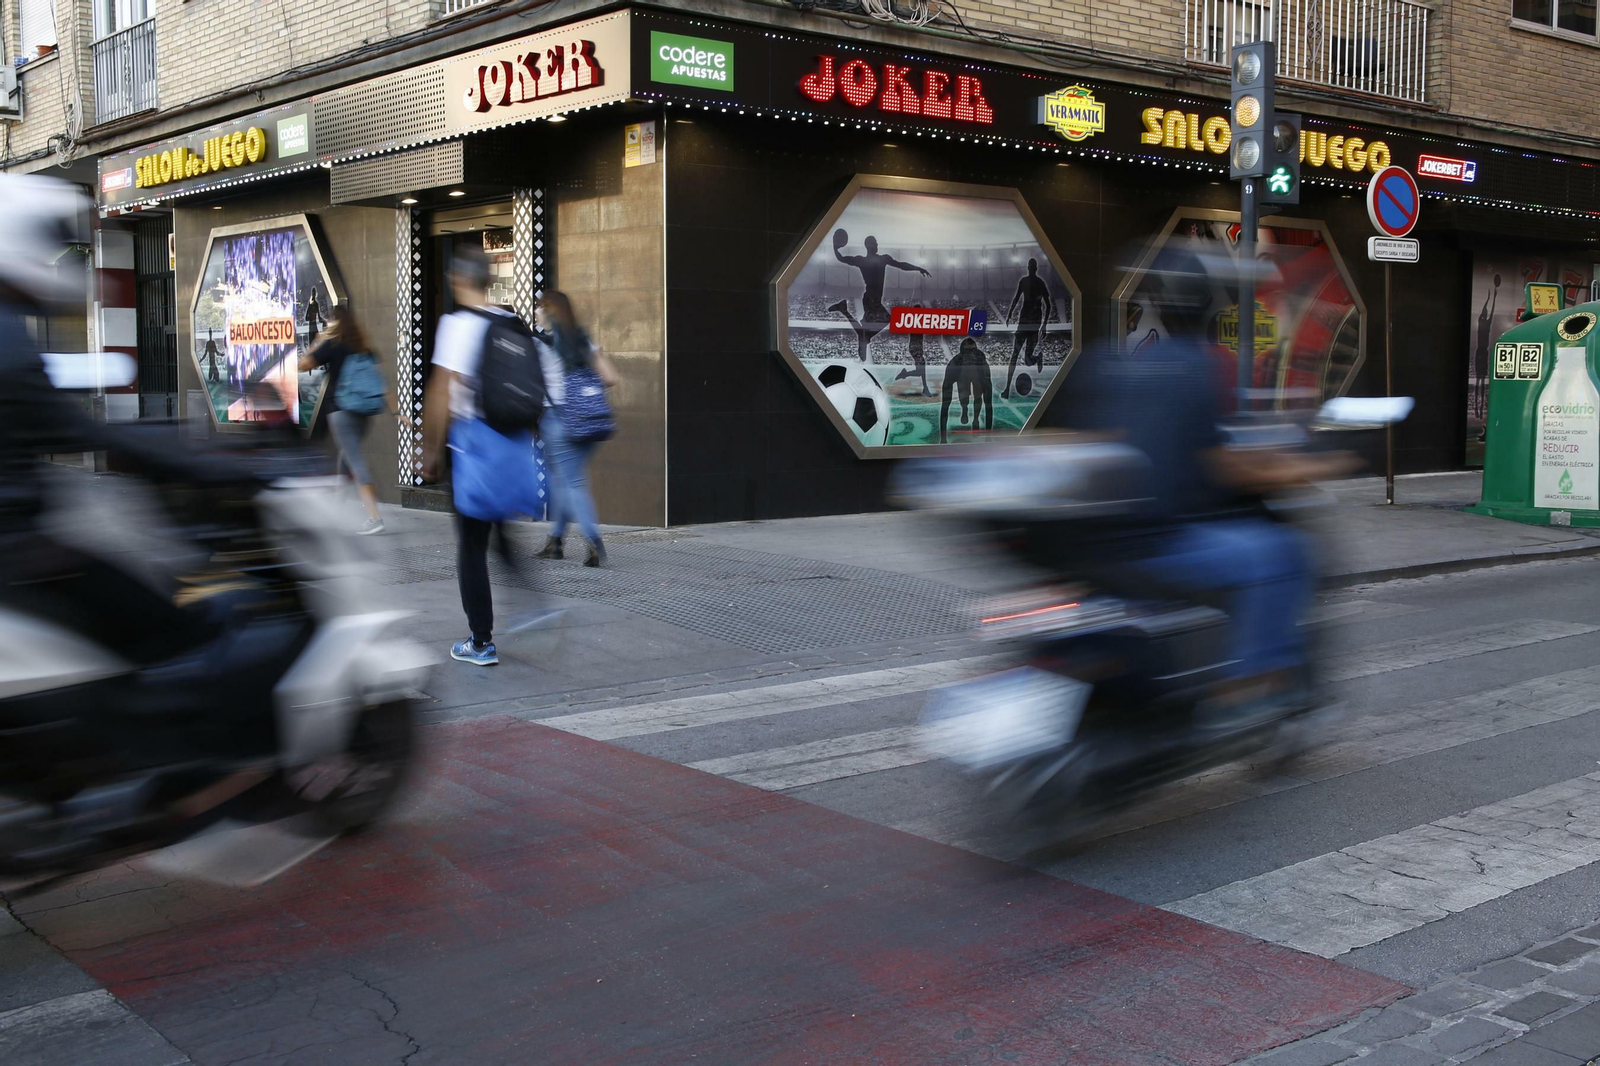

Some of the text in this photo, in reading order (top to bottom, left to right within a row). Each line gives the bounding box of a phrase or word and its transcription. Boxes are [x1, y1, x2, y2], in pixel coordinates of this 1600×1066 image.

[659, 45, 726, 68] codere
[462, 38, 605, 113] JOKER
[671, 64, 726, 82] APUESTAS
[800, 54, 994, 124] JOKER
[1050, 104, 1100, 124] VERAMATIC
[280, 124, 305, 140] codere
[135, 126, 267, 189] SALON de JUEGO
[1421, 160, 1463, 176] JOKERBET
[1245, 184, 1253, 195] 9
[230, 319, 293, 342] BALONCESTO
[895, 313, 984, 331] JOKERBET .es
[1500, 349, 1513, 362] B1
[1523, 350, 1537, 362] B2
[1542, 402, 1595, 415] ecovidrio
[1543, 443, 1579, 453] REDUCIR
